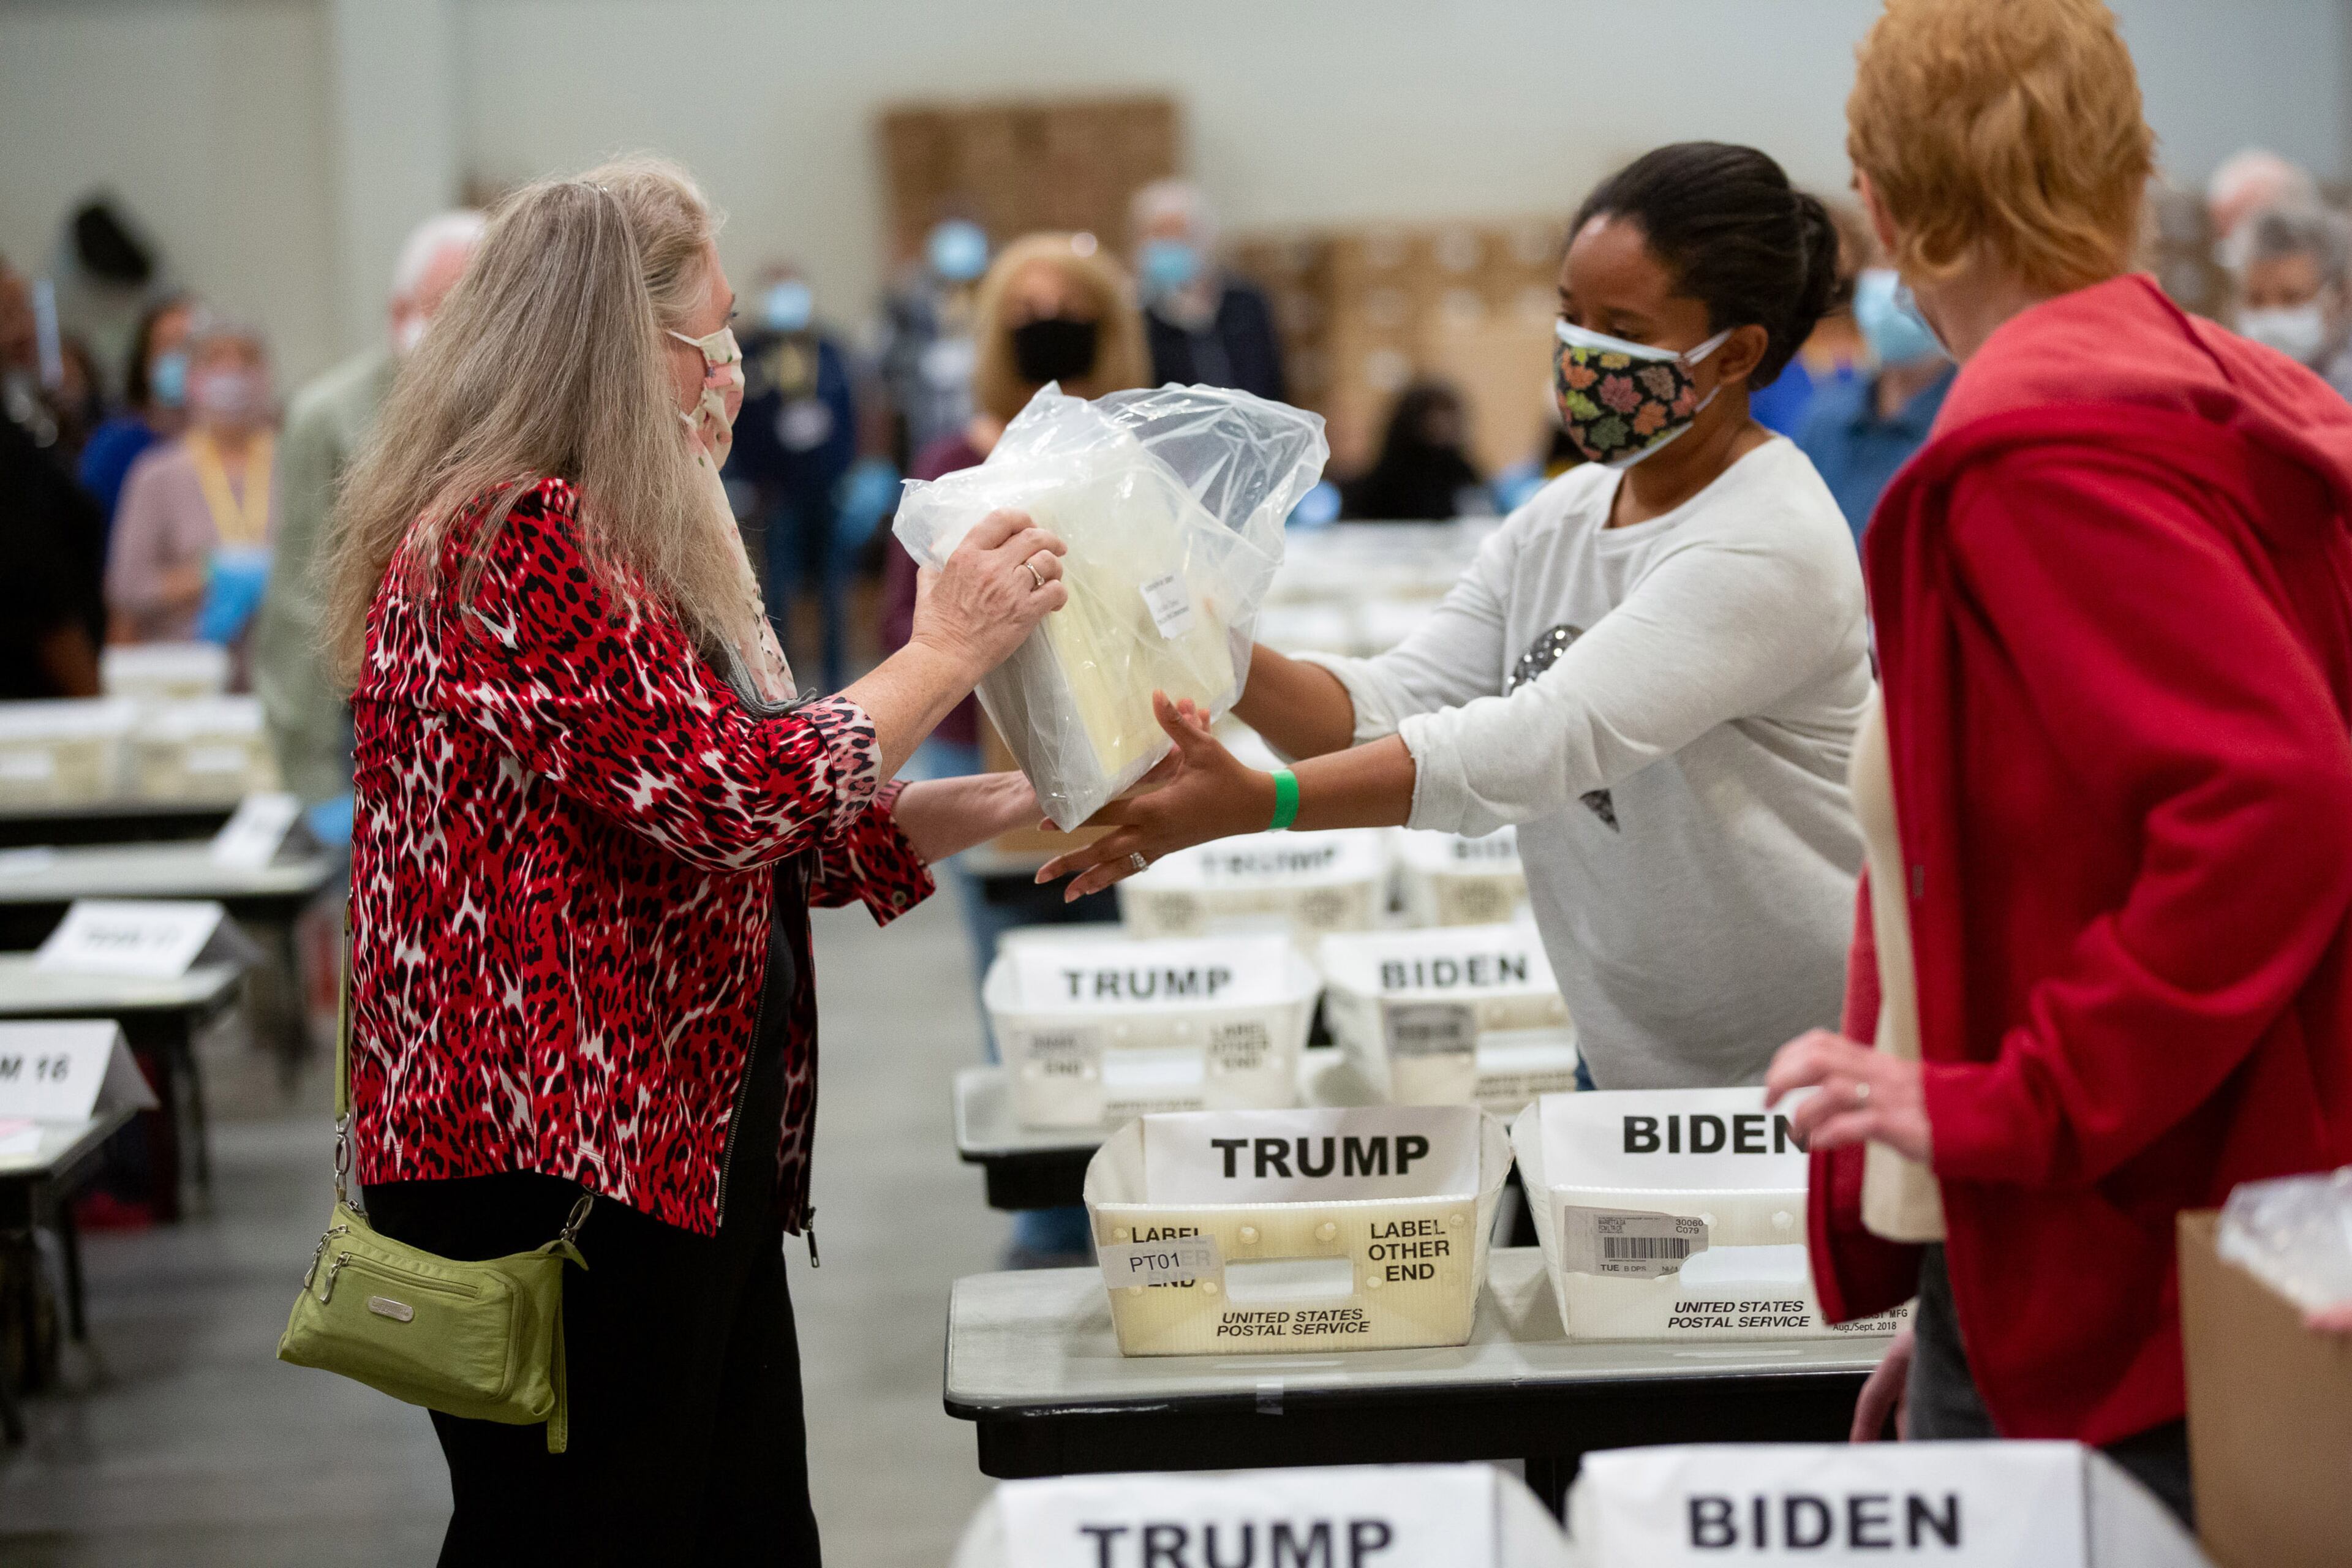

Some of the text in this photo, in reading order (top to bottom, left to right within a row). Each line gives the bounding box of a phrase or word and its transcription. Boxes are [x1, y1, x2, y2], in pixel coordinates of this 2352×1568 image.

[1381, 952, 1526, 989] BIDEN
[1062, 965, 1231, 998] TRUMP
[1211, 1135, 1430, 1178] TRUMP
[1370, 1219, 1446, 1240] LABEL
[1676, 1218, 1704, 1227] 30060
[1676, 1226, 1700, 1234] C079
[1368, 1240, 1450, 1261] OTHER
[1129, 1252, 1180, 1273] PT01
[1385, 1263, 1435, 1282] END
[1222, 1308, 1364, 1324] UNITED STATES
[1674, 1300, 1804, 1313] UNITED STATES
[1889, 1309, 1908, 1318] MFG
[1216, 1321, 1371, 1336] POSTAL SERVICE
[1668, 1316, 1811, 1329] POSTAL SERVICE
[1877, 1321, 1897, 1330] 2018
[1688, 1493, 1960, 1550] BIDEN
[1078, 1519, 1393, 1568] TRUMP
